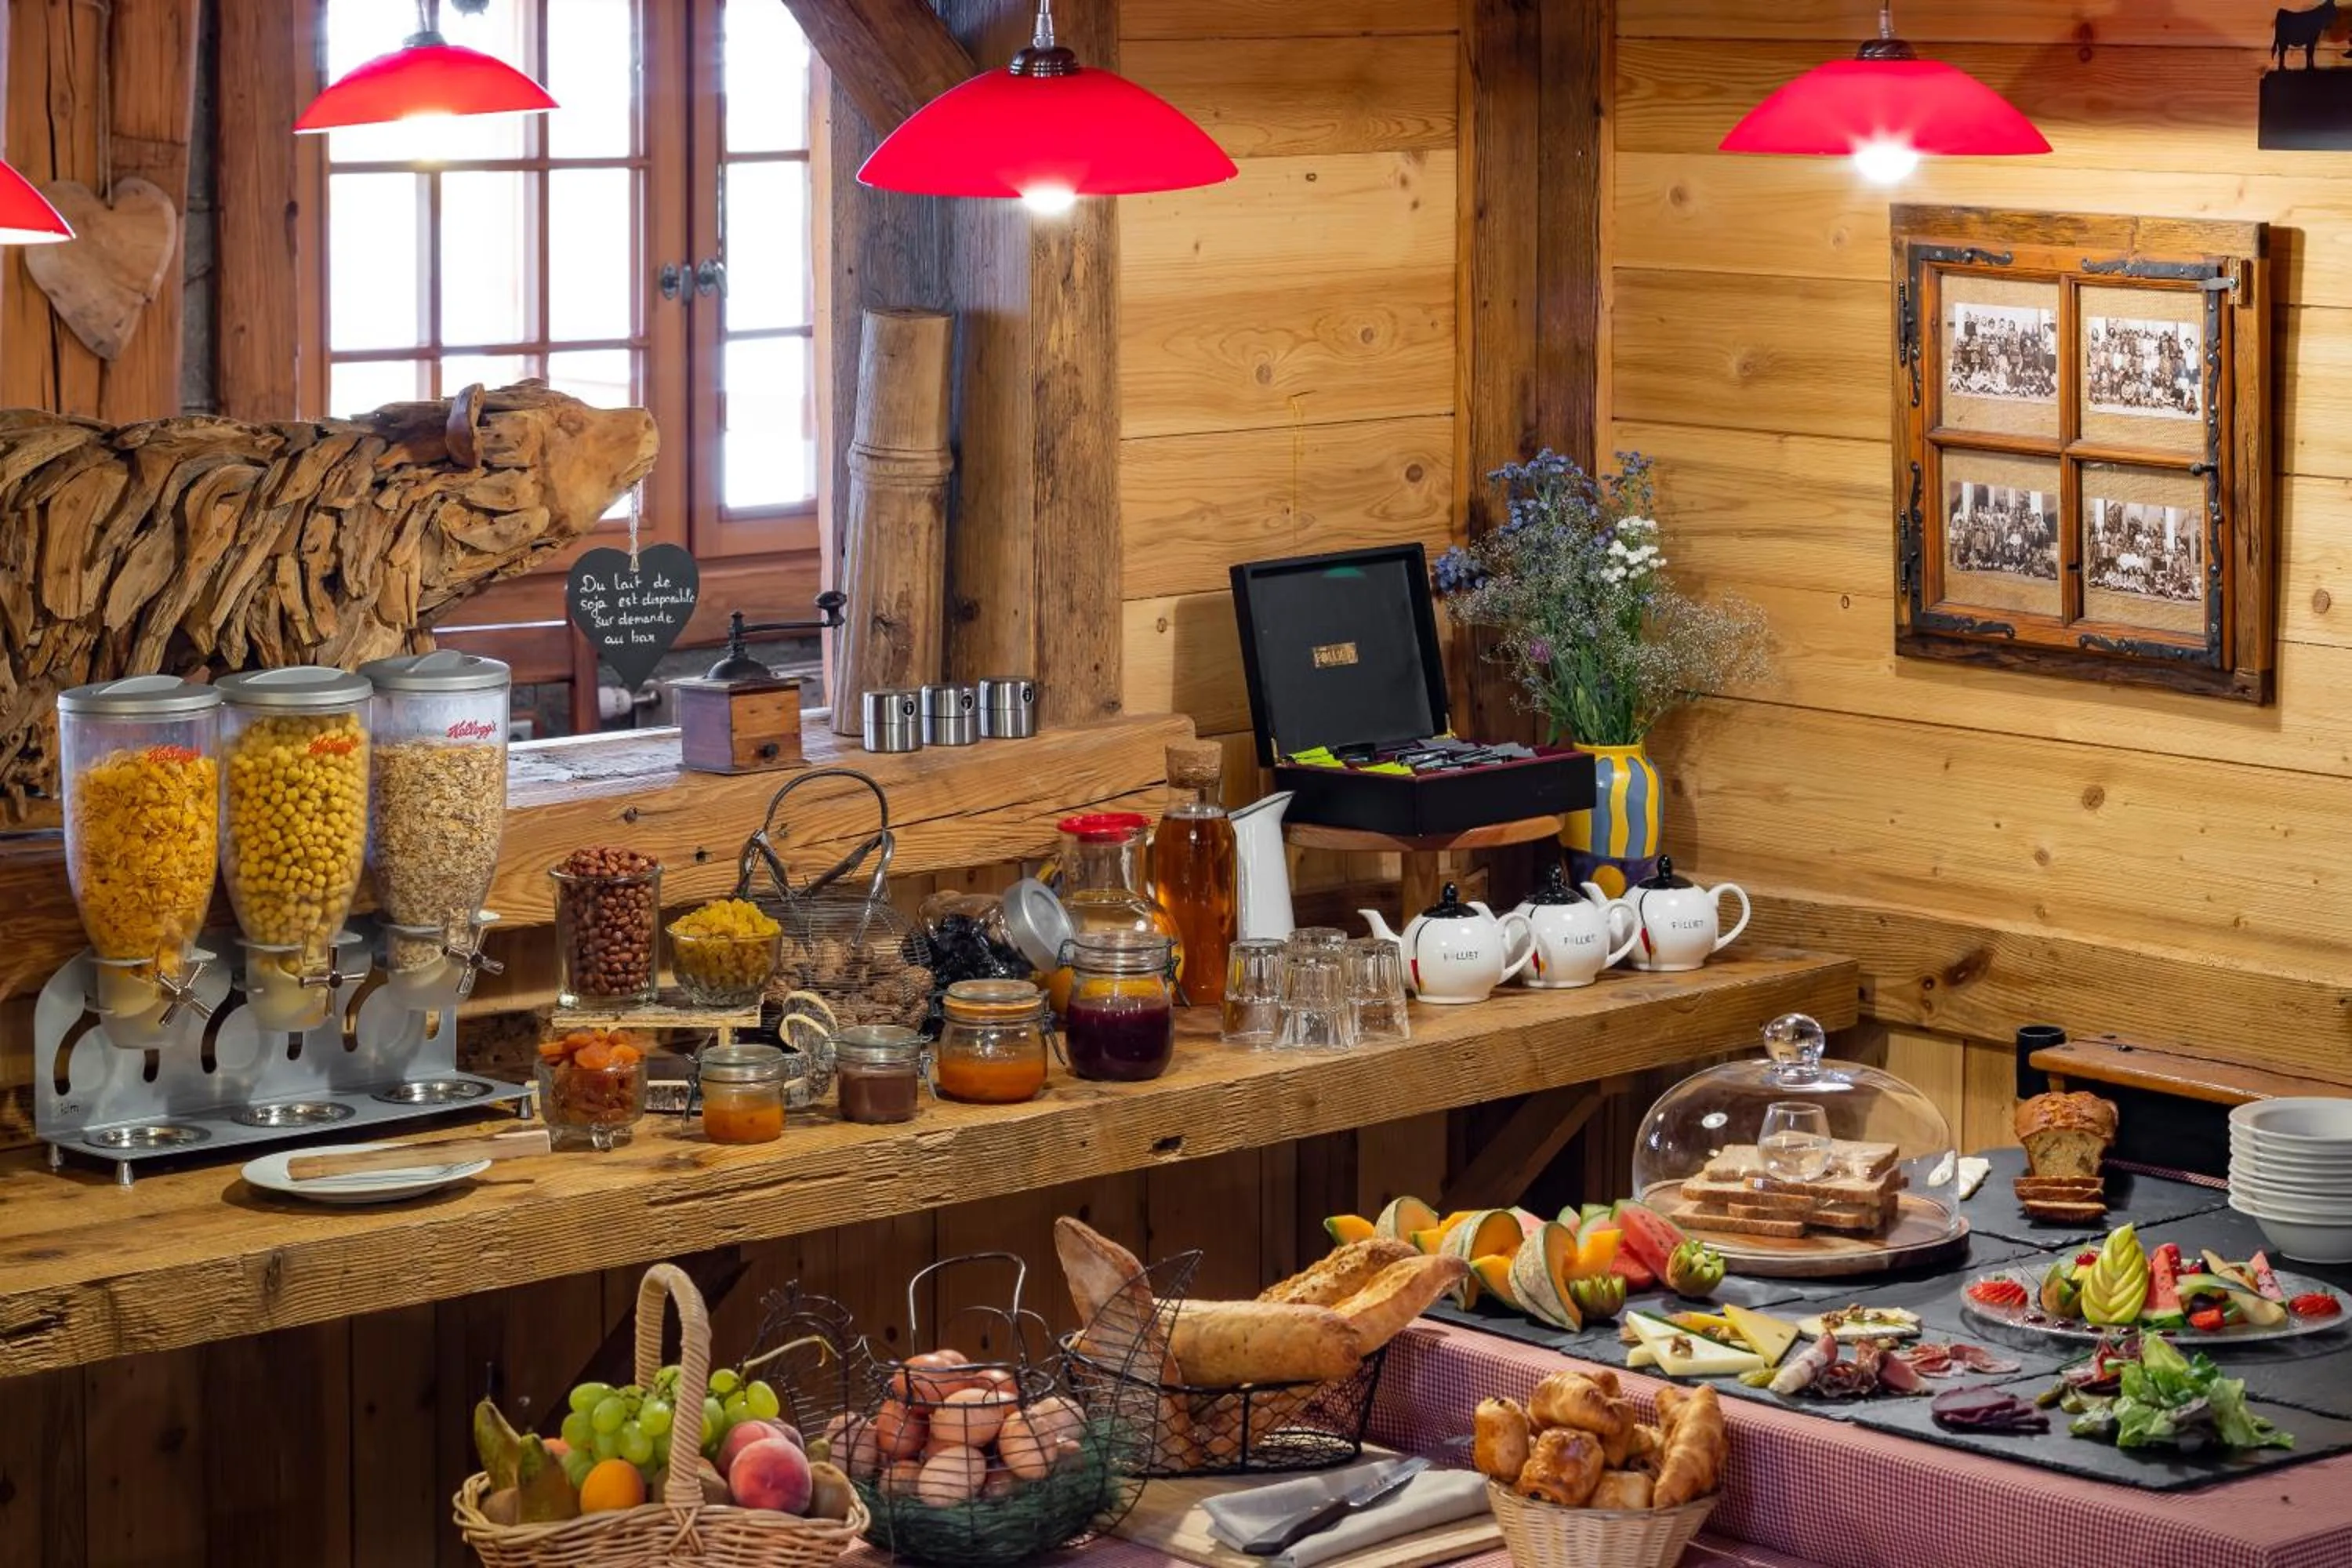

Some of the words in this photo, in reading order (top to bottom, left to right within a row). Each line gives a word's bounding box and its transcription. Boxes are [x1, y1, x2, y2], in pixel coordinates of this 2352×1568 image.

[580, 575, 605, 593] Du
[615, 573, 642, 590] lait
[654, 572, 671, 588] de
[580, 595, 608, 619] soja
[619, 593, 637, 607] est
[618, 612, 675, 626] demande
[604, 635, 623, 644] au
[631, 630, 655, 644] bar
[1443, 951, 1479, 961] FLLIET
